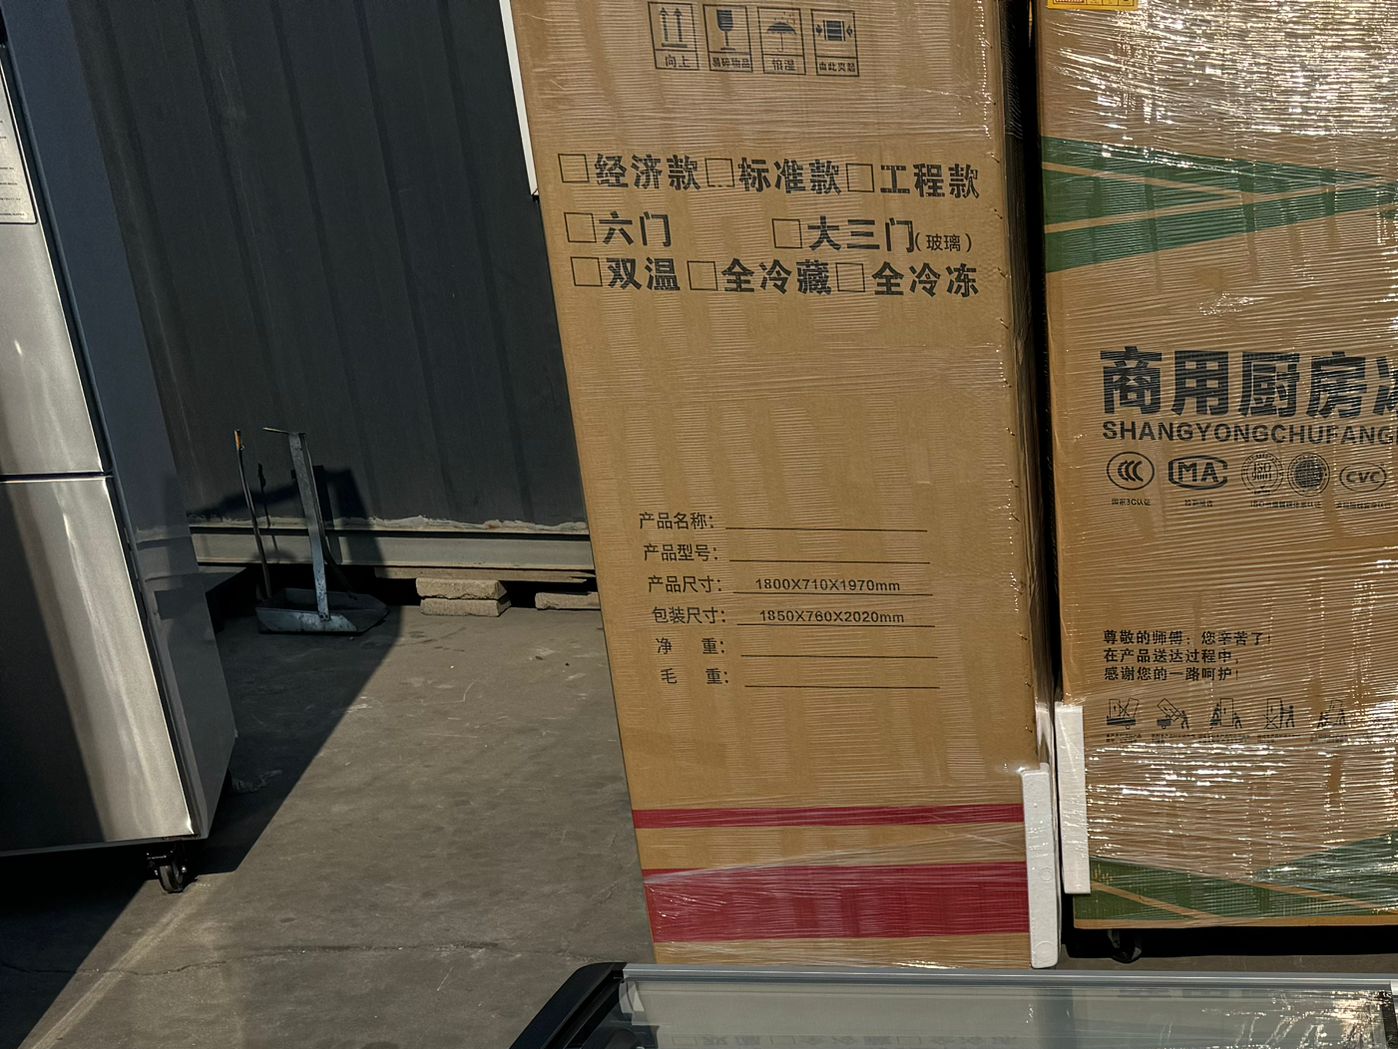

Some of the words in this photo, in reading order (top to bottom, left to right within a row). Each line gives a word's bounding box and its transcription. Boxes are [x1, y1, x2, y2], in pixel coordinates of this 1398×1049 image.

[665, 54, 691, 68] 向上
[594, 153, 700, 191] 经济款
[738, 157, 841, 195] 标准款
[880, 163, 980, 199] 工程款
[599, 211, 672, 247] 六门
[606, 256, 680, 291] 双温
[721, 257, 832, 295] 全冷藏
[871, 261, 980, 298] 全冷冻
[639, 512, 714, 530] 产品名称：
[643, 544, 718, 562] 产品型号：
[648, 575, 722, 593] 产品尺寸：
[755, 578, 901, 592] 1800X710X1970mm
[652, 606, 726, 624] 包装尺寸：
[759, 609, 905, 623] 1850X760X2020mm
